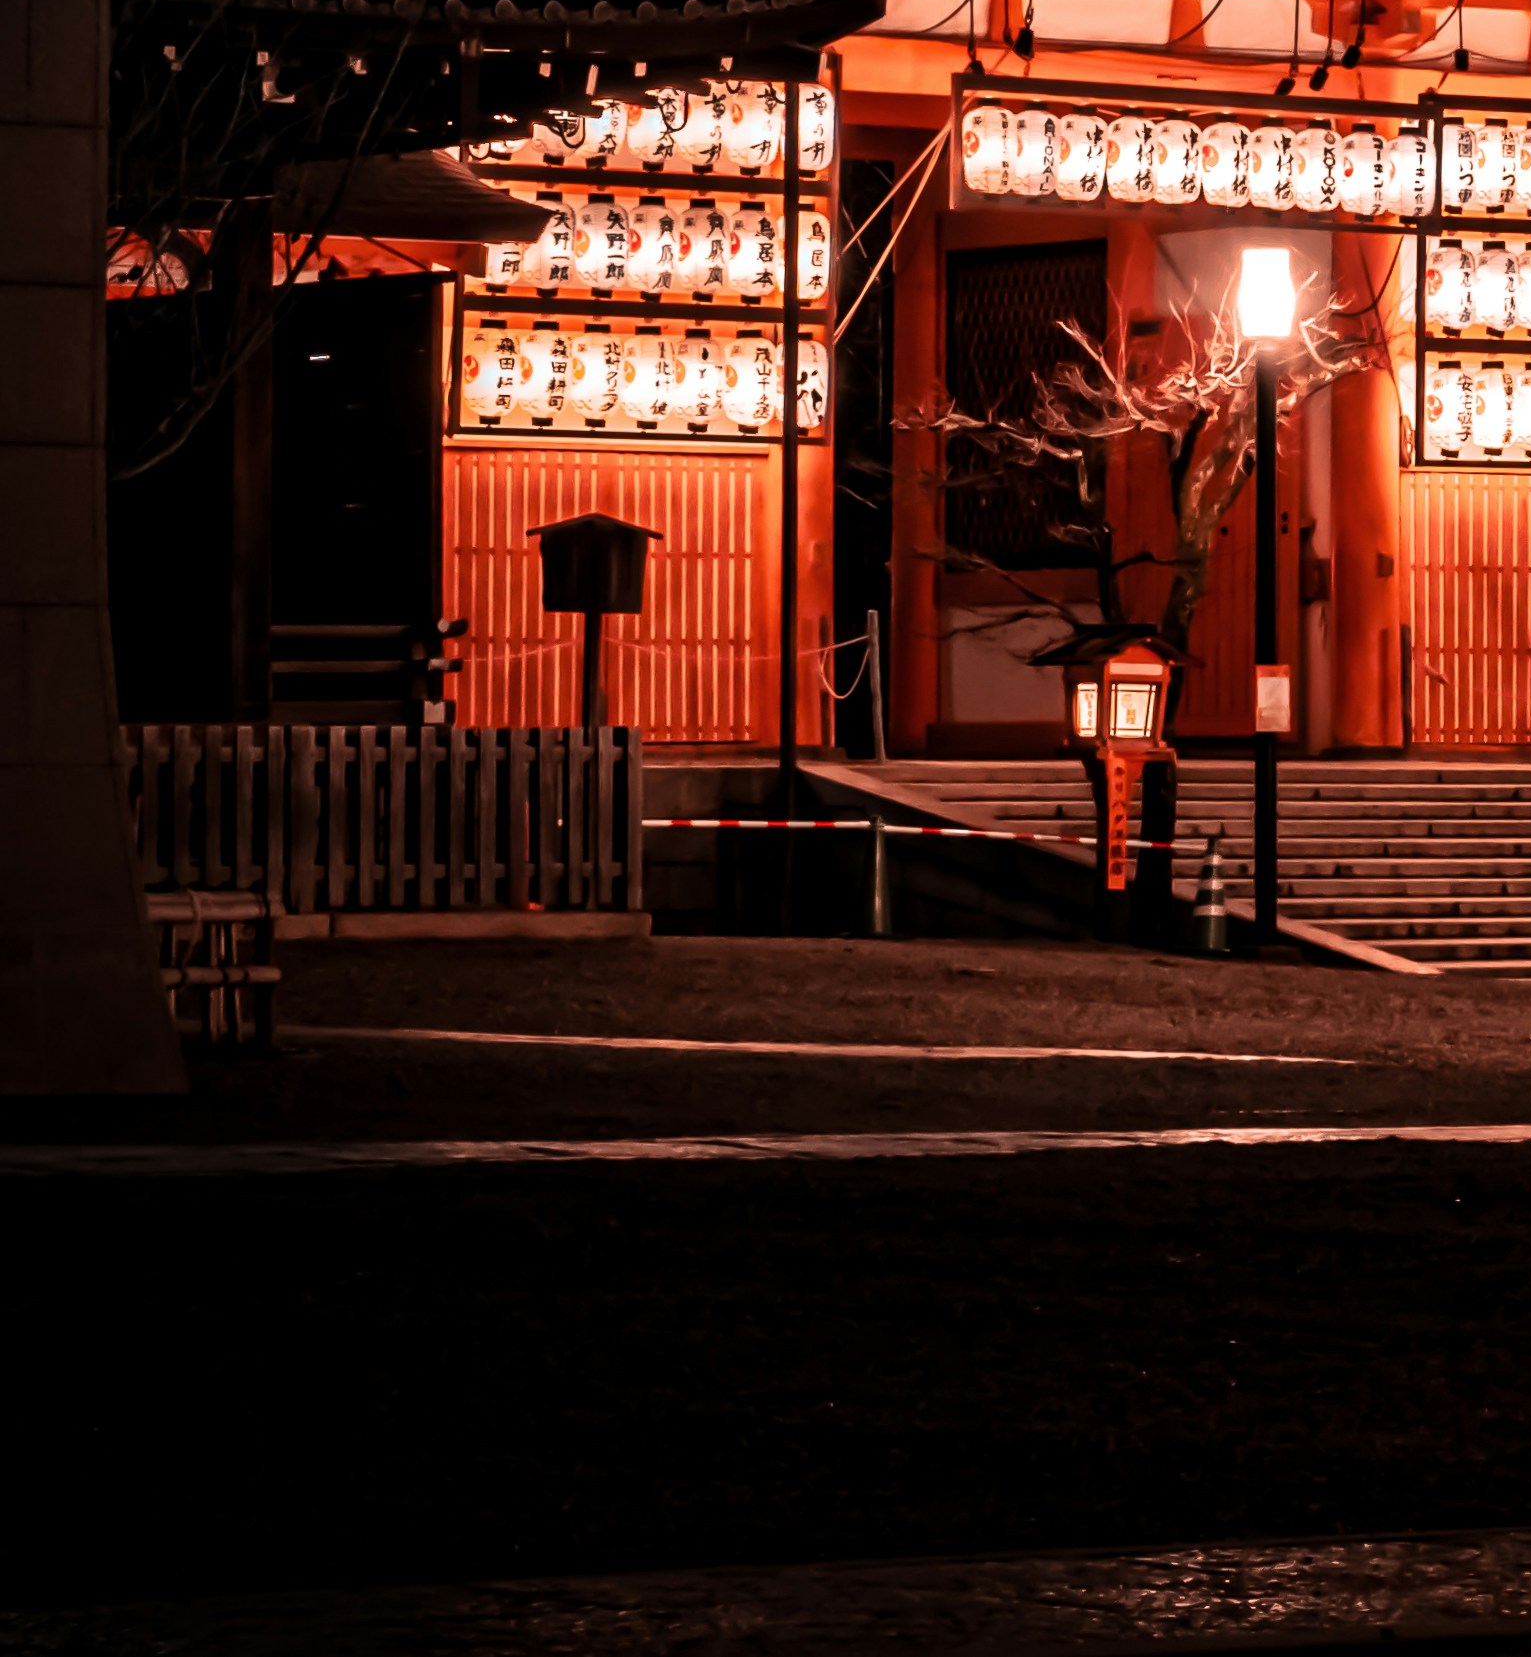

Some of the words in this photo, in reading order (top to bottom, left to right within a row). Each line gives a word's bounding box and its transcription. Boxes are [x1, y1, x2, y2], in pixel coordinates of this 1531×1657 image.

[605, 210, 625, 279] 矢野一郎
[752, 216, 775, 288] 鳥居本
[806, 220, 826, 290] 鳥居本
